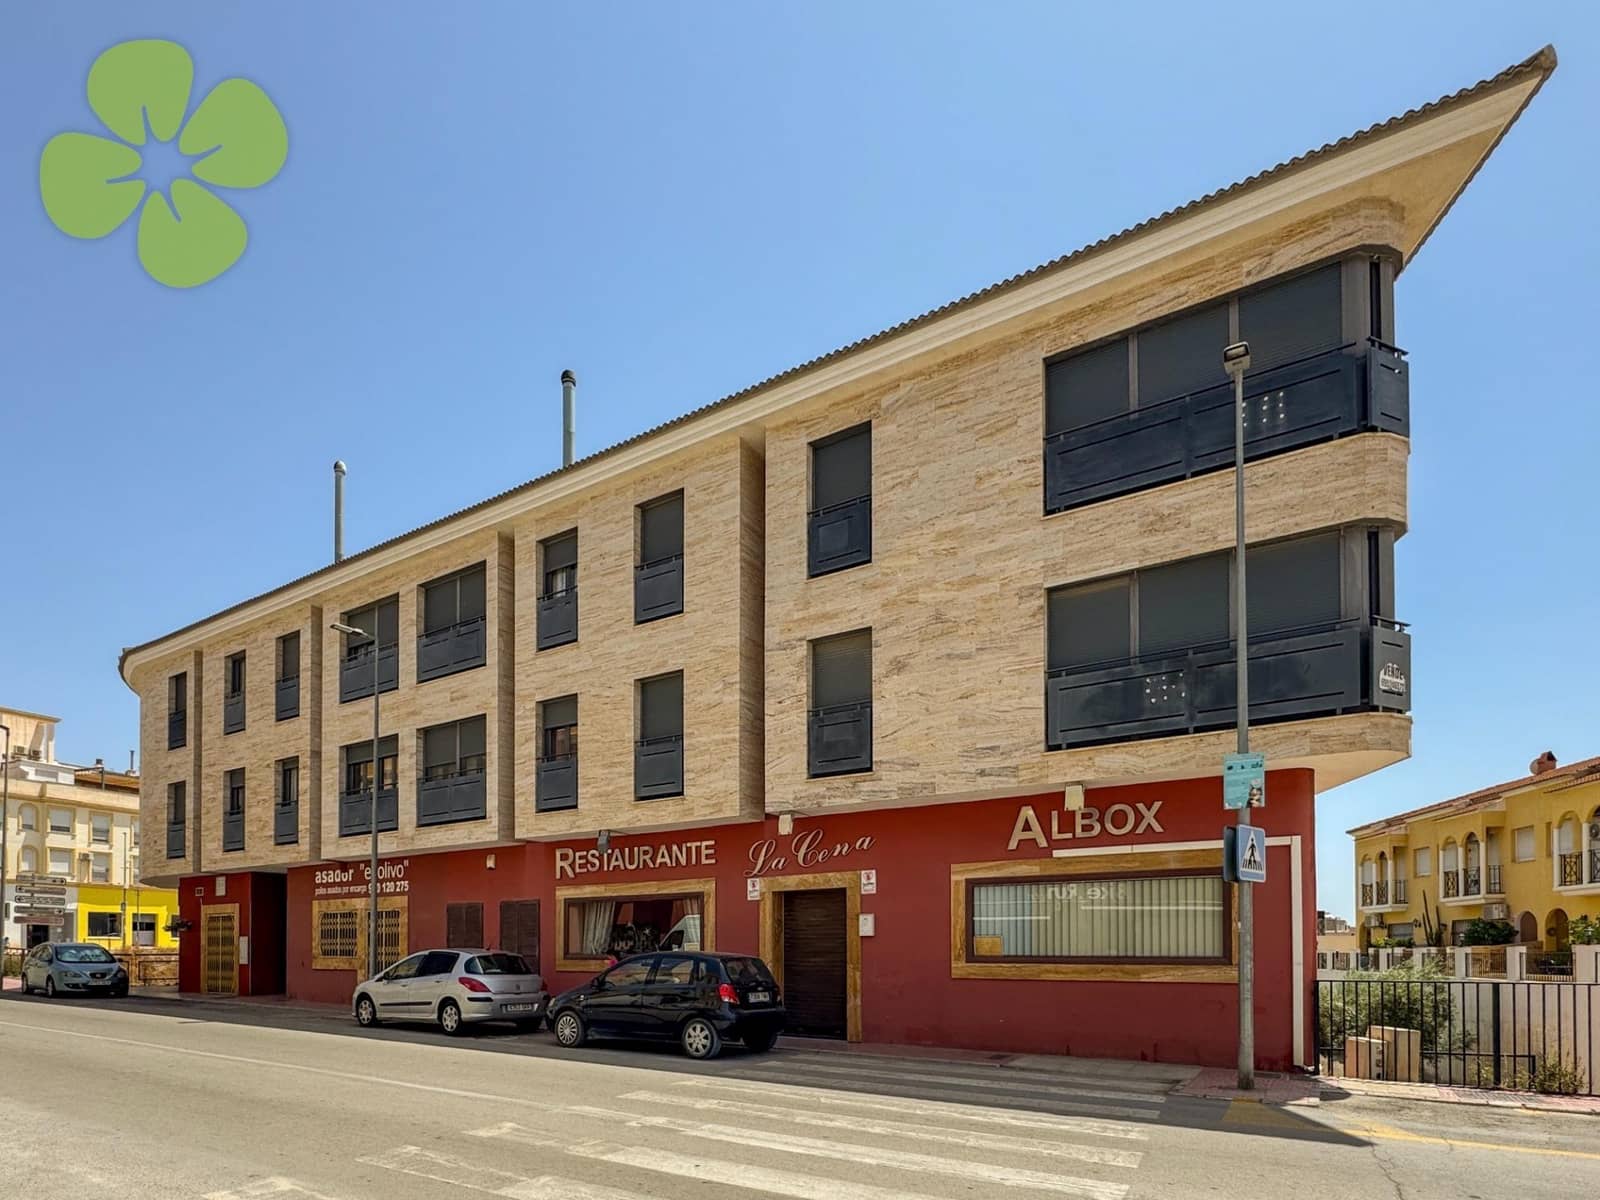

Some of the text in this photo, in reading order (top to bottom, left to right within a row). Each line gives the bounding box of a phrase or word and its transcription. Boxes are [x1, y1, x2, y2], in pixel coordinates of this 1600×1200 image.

[1007, 801, 1164, 850] ALBOX
[555, 840, 716, 879] RESTAURANTE
[743, 829, 876, 877] La Cena
[315, 868, 354, 883] asador
[360, 863, 374, 881] "e
[396, 880, 409, 892] 275
